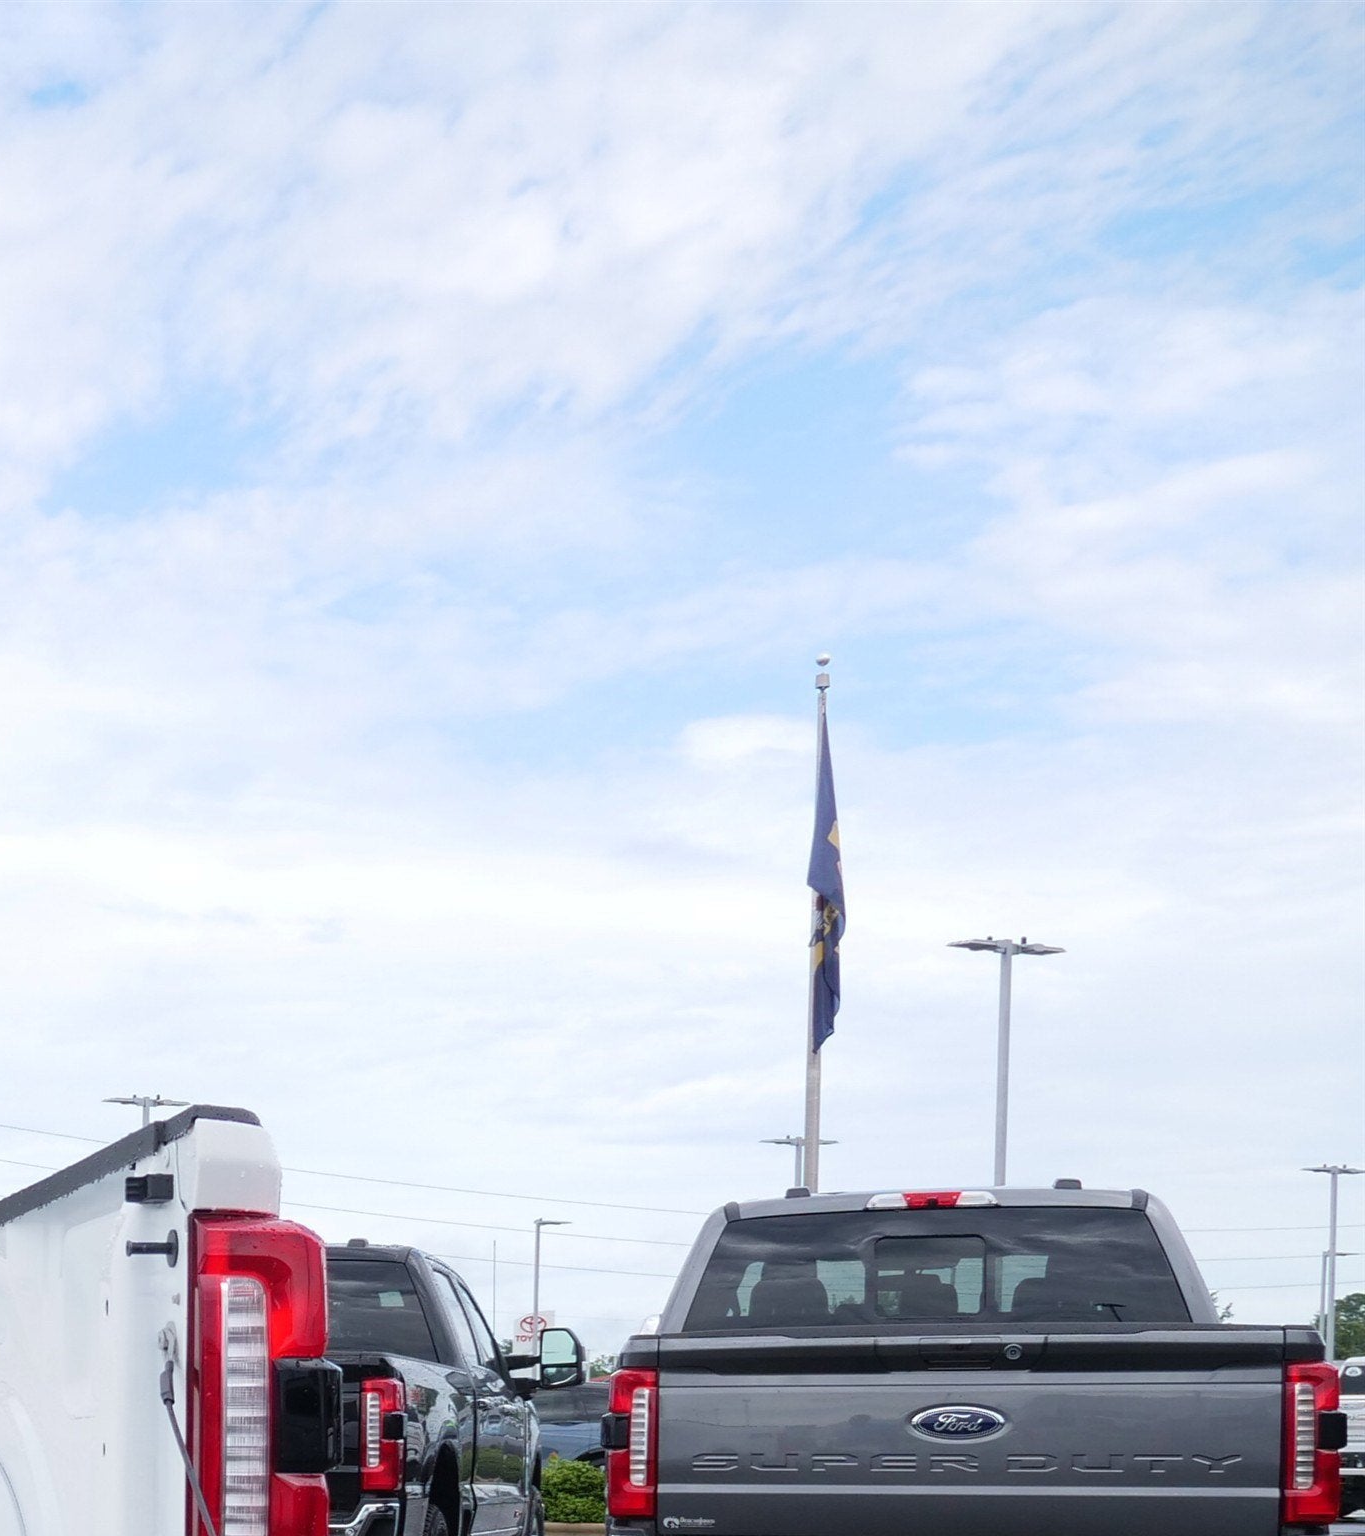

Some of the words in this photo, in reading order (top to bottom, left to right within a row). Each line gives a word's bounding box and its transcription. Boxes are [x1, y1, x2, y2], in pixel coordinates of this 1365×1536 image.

[933, 1413, 983, 1431] Ford
[691, 1453, 978, 1472] SUPER
[1006, 1453, 1243, 1473] DUTY
